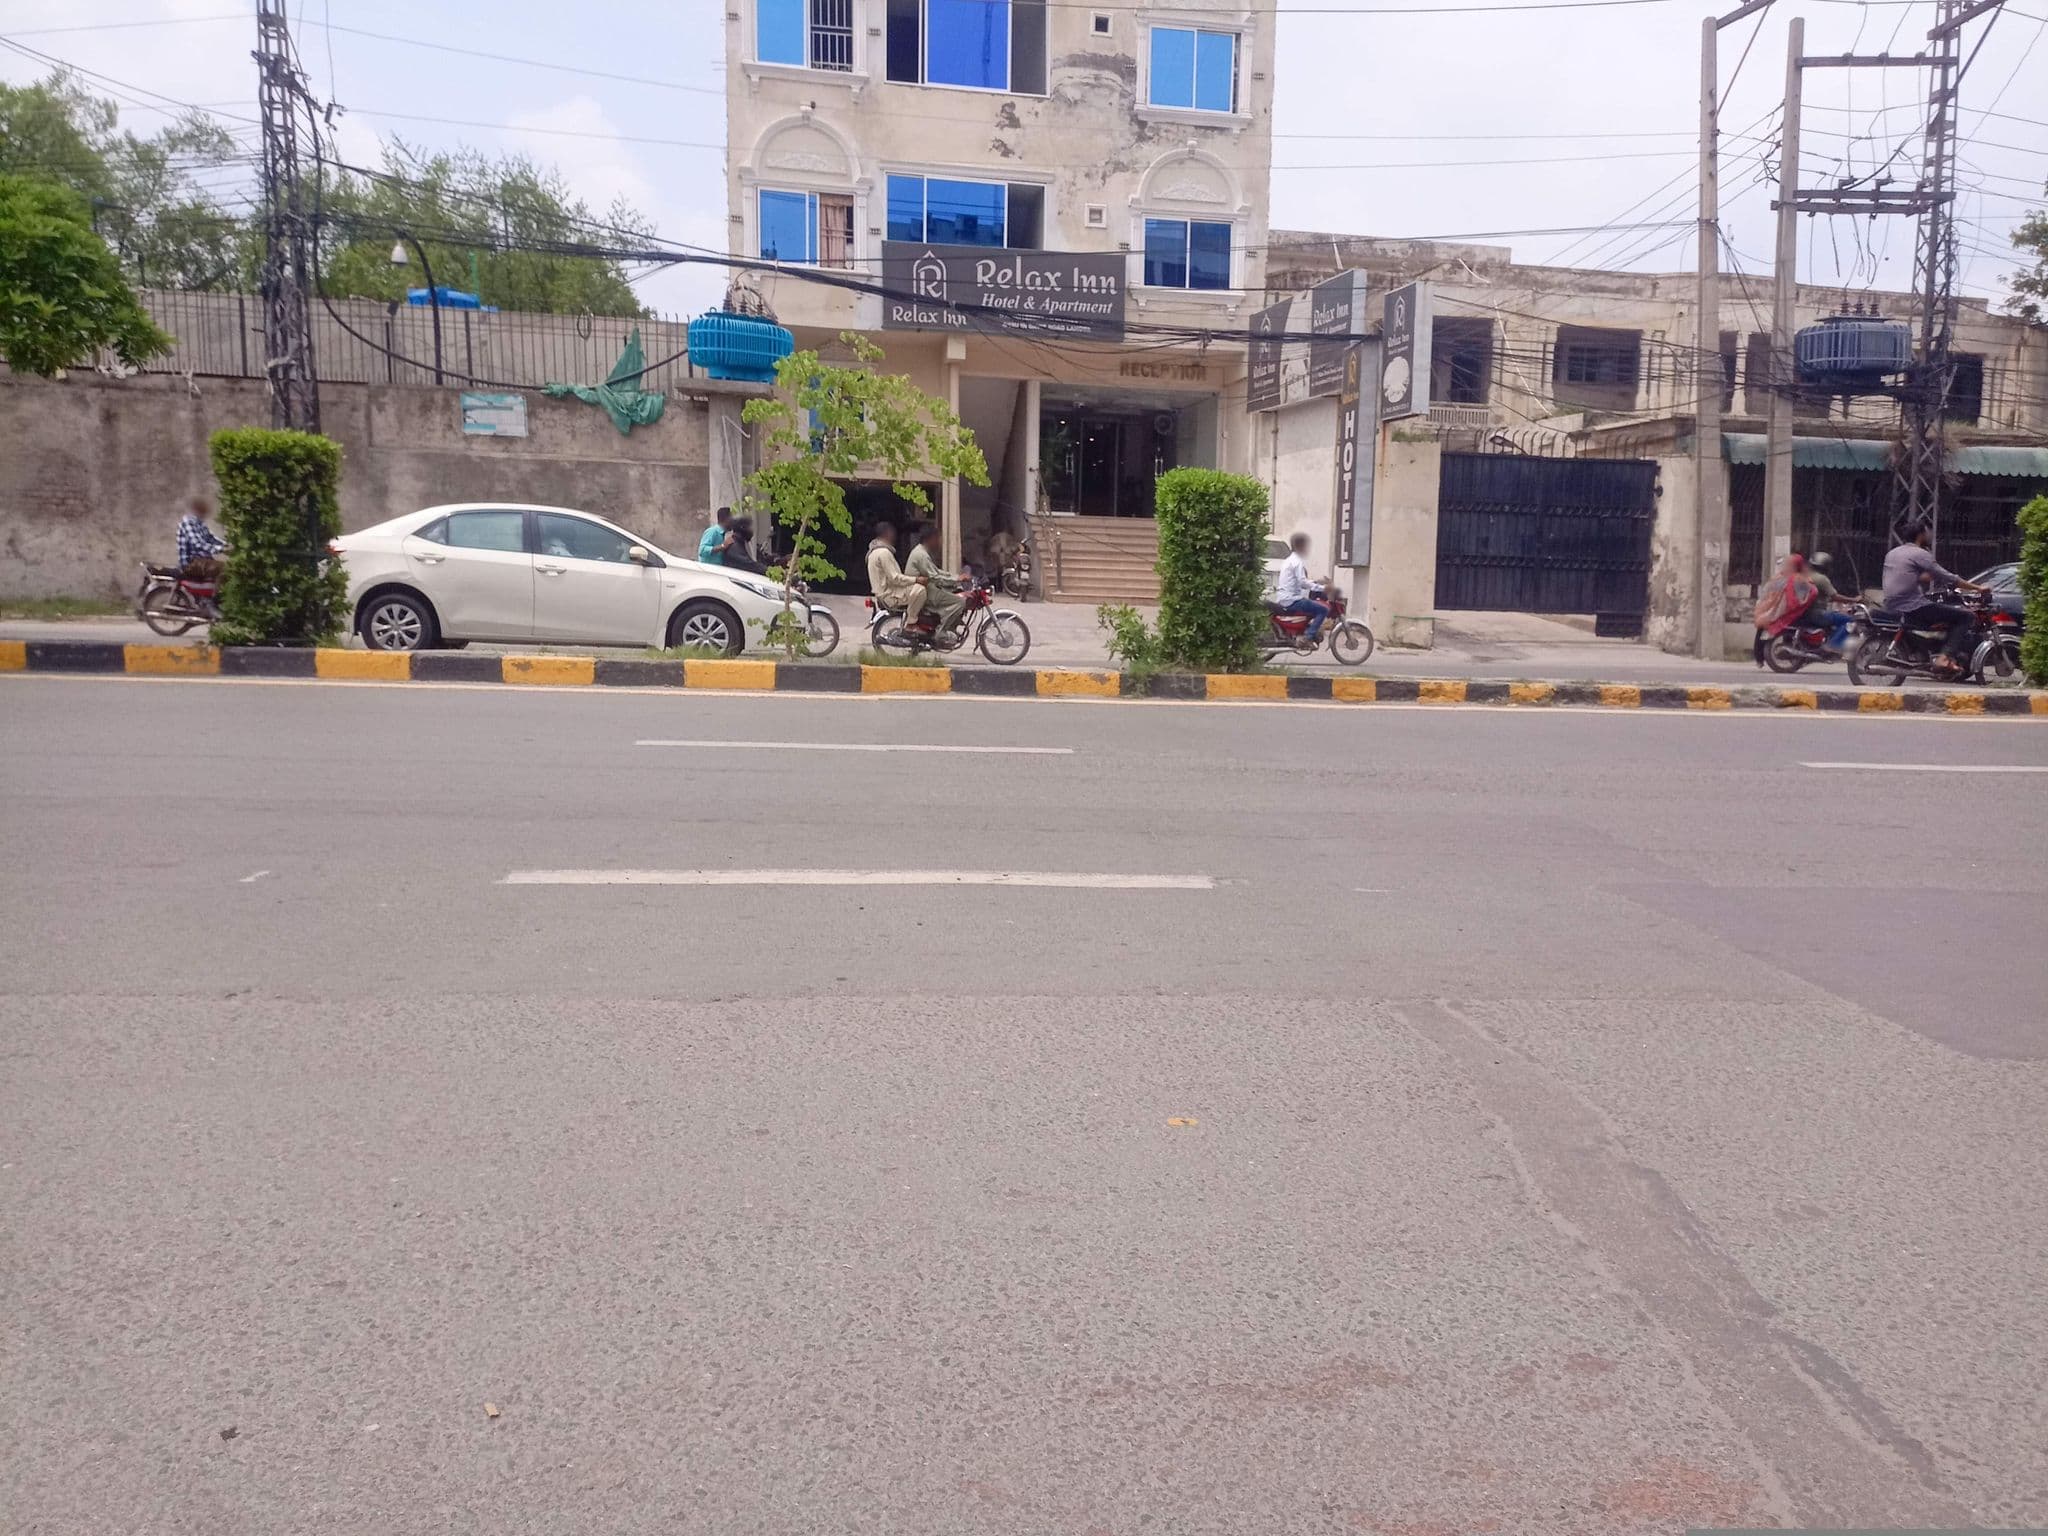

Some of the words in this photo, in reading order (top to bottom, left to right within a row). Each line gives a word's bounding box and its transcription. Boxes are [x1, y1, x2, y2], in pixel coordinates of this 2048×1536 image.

[976, 256, 1062, 292] Relax
[1073, 267, 1118, 295] Inn
[893, 304, 938, 324] Relax
[943, 309, 968, 328] Inn
[982, 293, 1020, 309] Hotel
[1024, 296, 1035, 310] &
[1041, 297, 1113, 315] Apartment
[1313, 304, 1335, 328] Relax
[1336, 303, 1349, 319] Inn
[1119, 360, 1207, 382] RECEPTION
[1340, 410, 1356, 561] HOTEL
